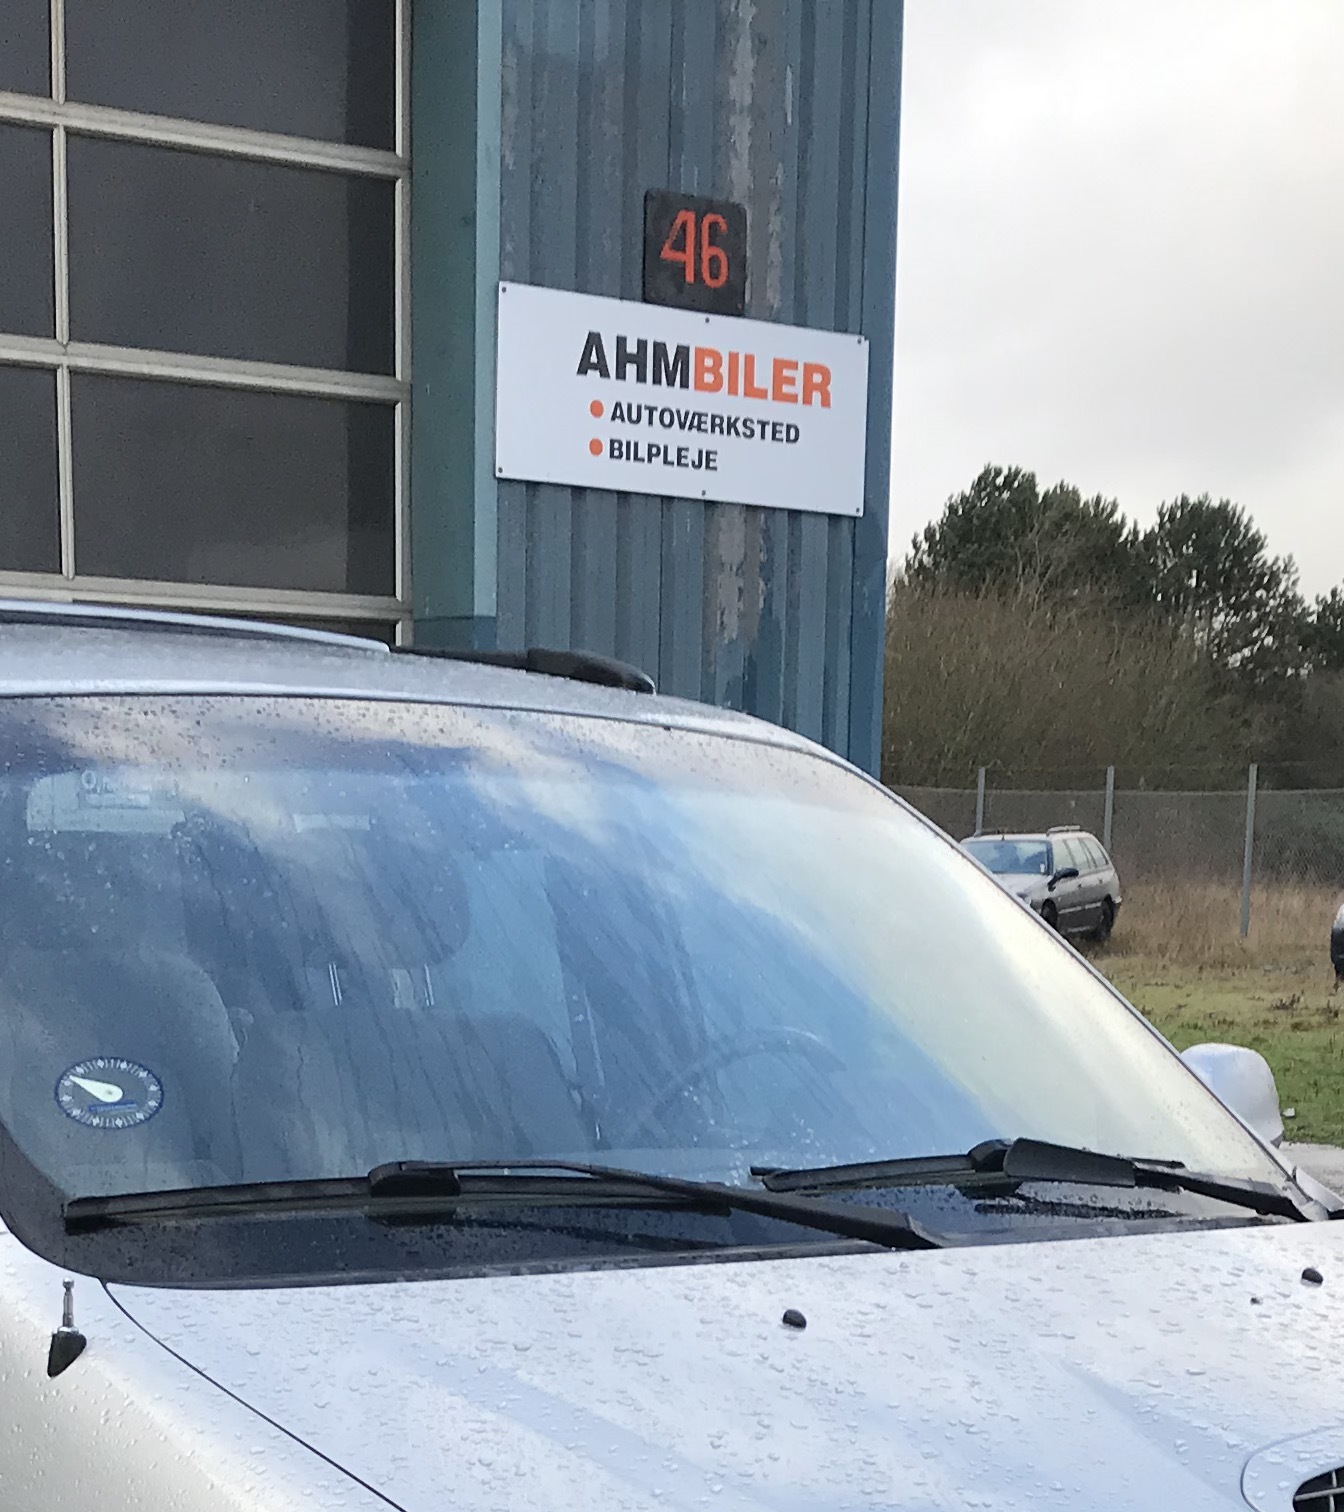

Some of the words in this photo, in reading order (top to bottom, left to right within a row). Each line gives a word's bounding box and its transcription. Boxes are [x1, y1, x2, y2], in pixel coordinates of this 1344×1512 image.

[659, 208, 730, 289] 46
[575, 330, 832, 409] AHMBILER
[609, 400, 801, 445] AUTOVÆRKSTED
[608, 438, 719, 471] BILPLEJE
